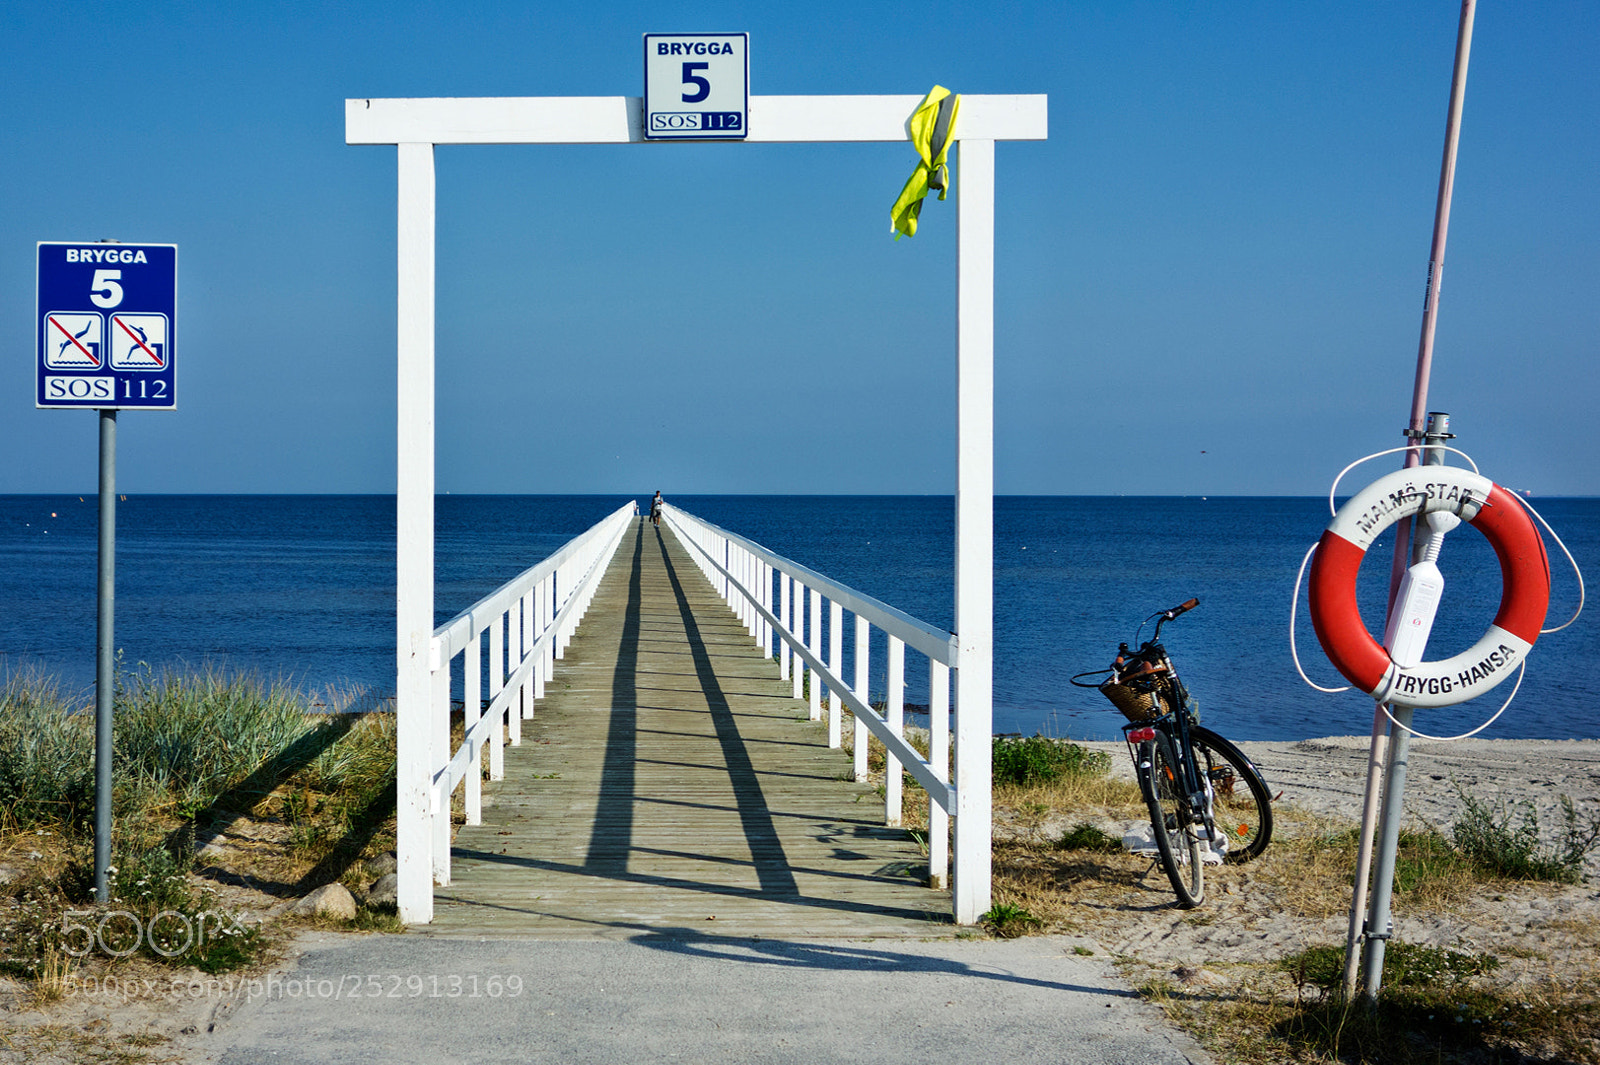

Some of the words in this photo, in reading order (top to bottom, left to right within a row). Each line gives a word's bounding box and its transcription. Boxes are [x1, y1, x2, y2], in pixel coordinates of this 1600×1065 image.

[657, 42, 734, 56] BRYGGA
[681, 61, 711, 104] 5
[655, 115, 698, 128] SOS
[707, 114, 739, 128] 112
[66, 248, 148, 264] BRYGGA
[89, 269, 124, 309] 5
[50, 378, 110, 398] SOS
[122, 379, 168, 399] 112
[1356, 482, 1418, 534] MALMÖ
[1395, 644, 1516, 695] TRYGG-HANSA
